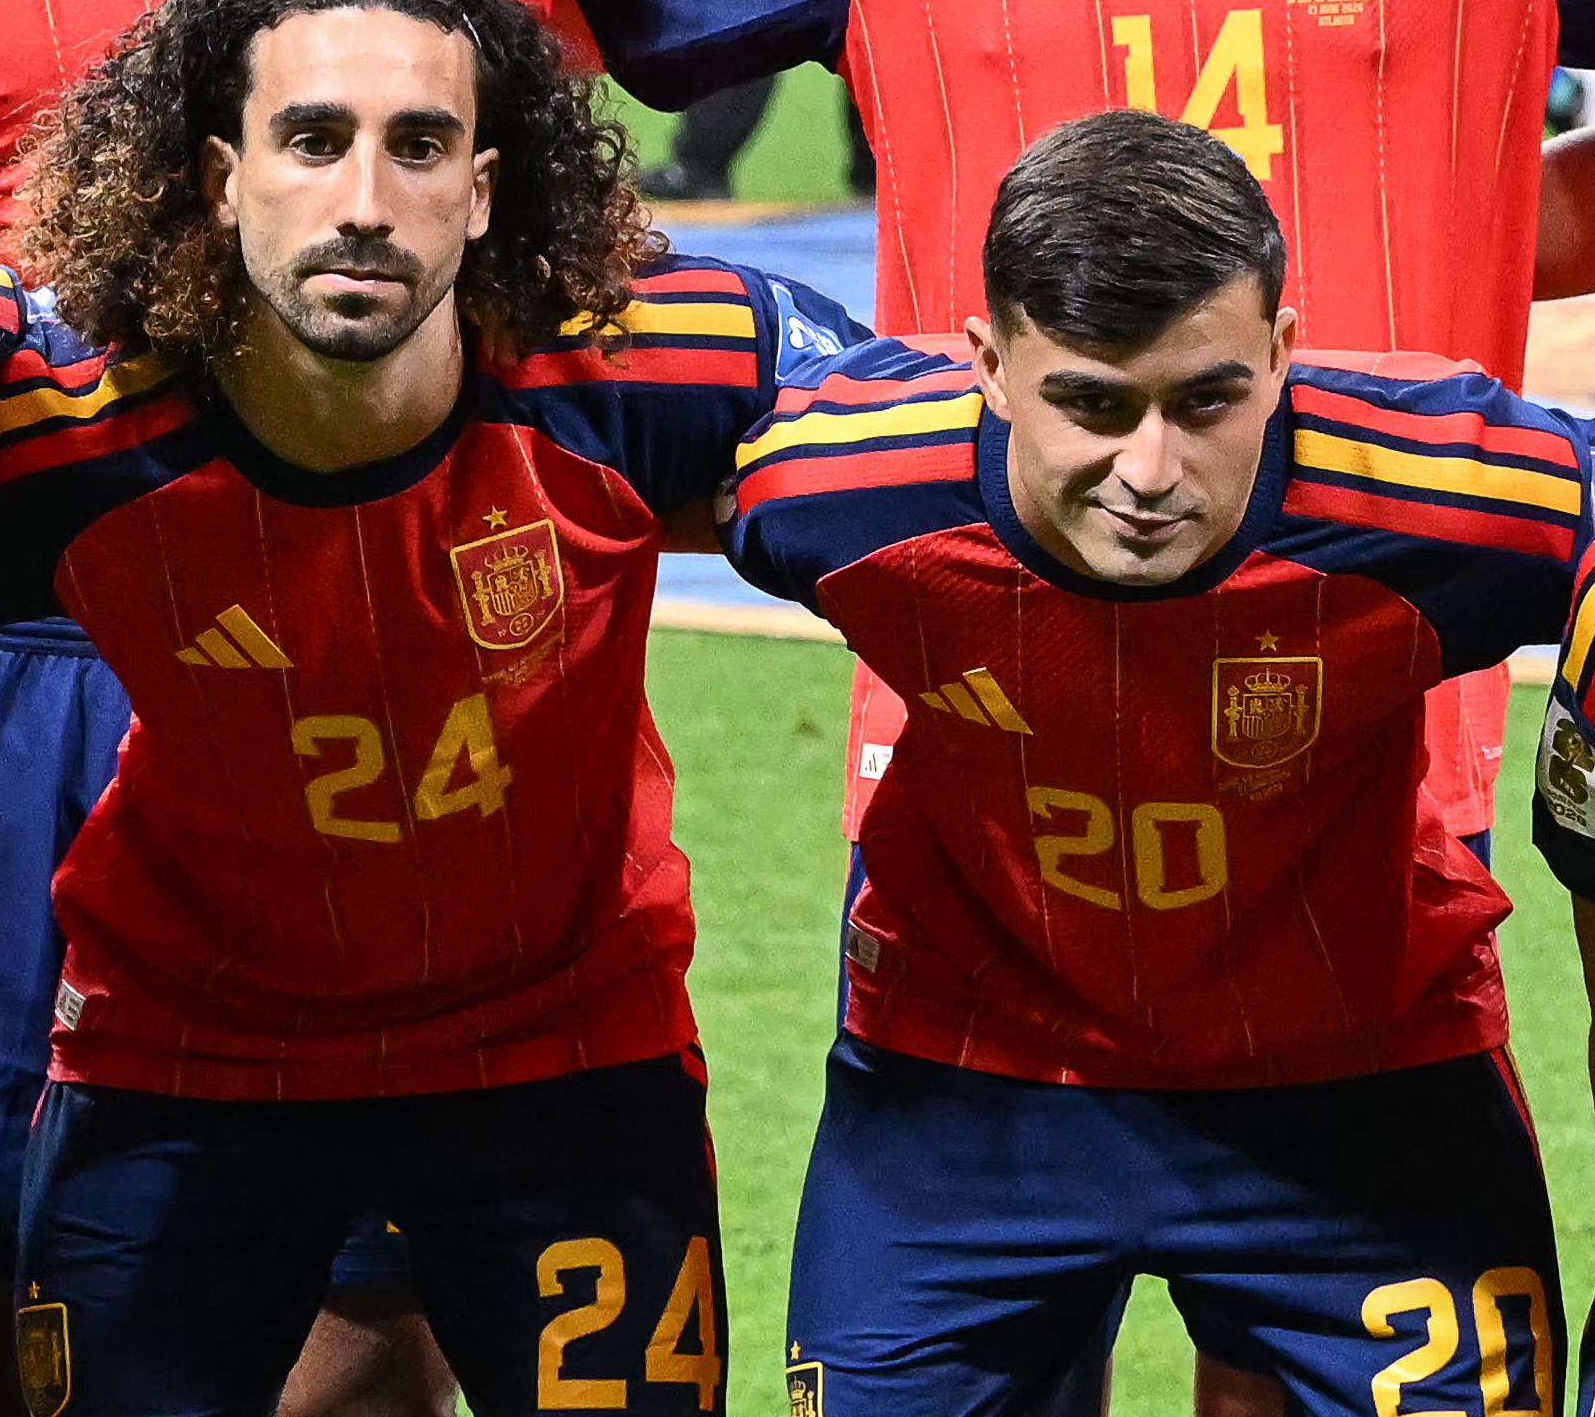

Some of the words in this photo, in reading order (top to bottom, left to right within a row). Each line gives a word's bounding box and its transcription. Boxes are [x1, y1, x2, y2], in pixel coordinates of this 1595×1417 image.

[1112, 9, 1283, 182] 14
[290, 691, 513, 842] 24
[1026, 786, 1226, 910] 20
[536, 1237, 721, 1410] 24
